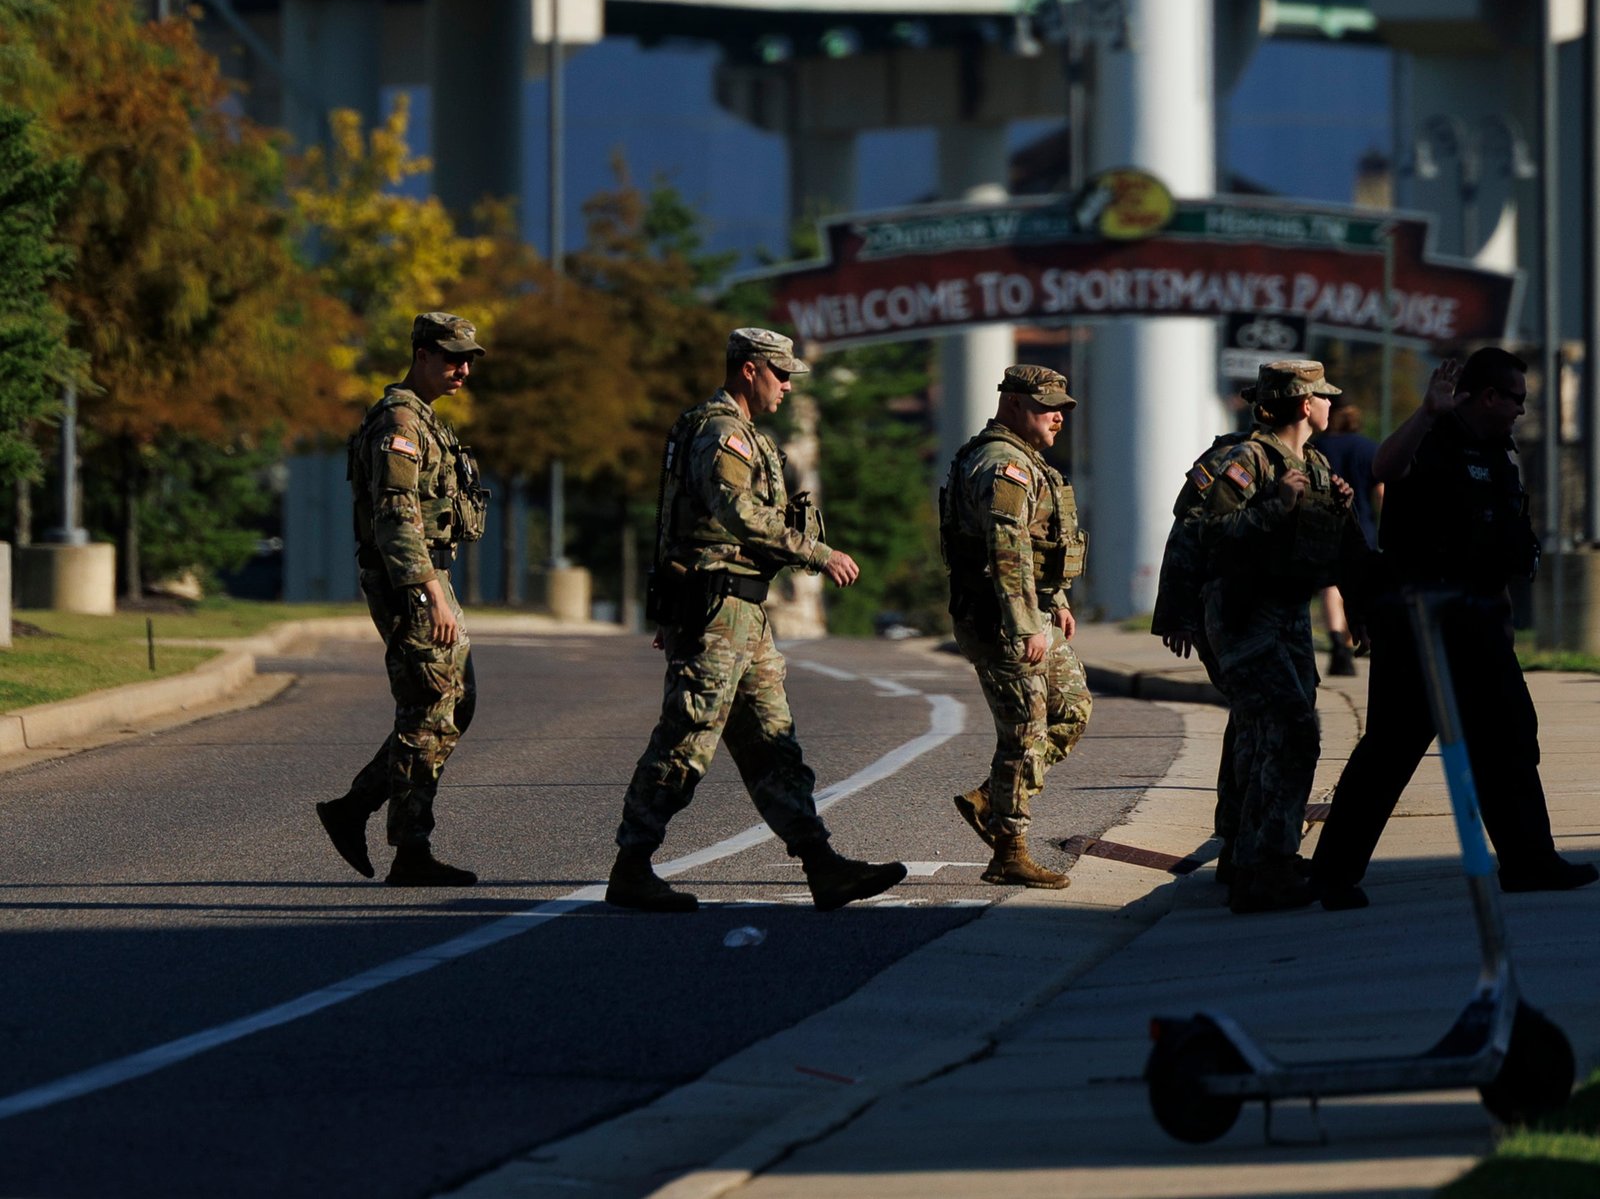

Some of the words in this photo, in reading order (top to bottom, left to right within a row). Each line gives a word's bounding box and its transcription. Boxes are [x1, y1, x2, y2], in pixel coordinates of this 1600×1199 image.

[789, 278, 970, 338] WELCOME
[975, 272, 1034, 317] TO
[1041, 267, 1287, 314] SPORTSMAN'S
[1291, 274, 1460, 338] PARADISE
